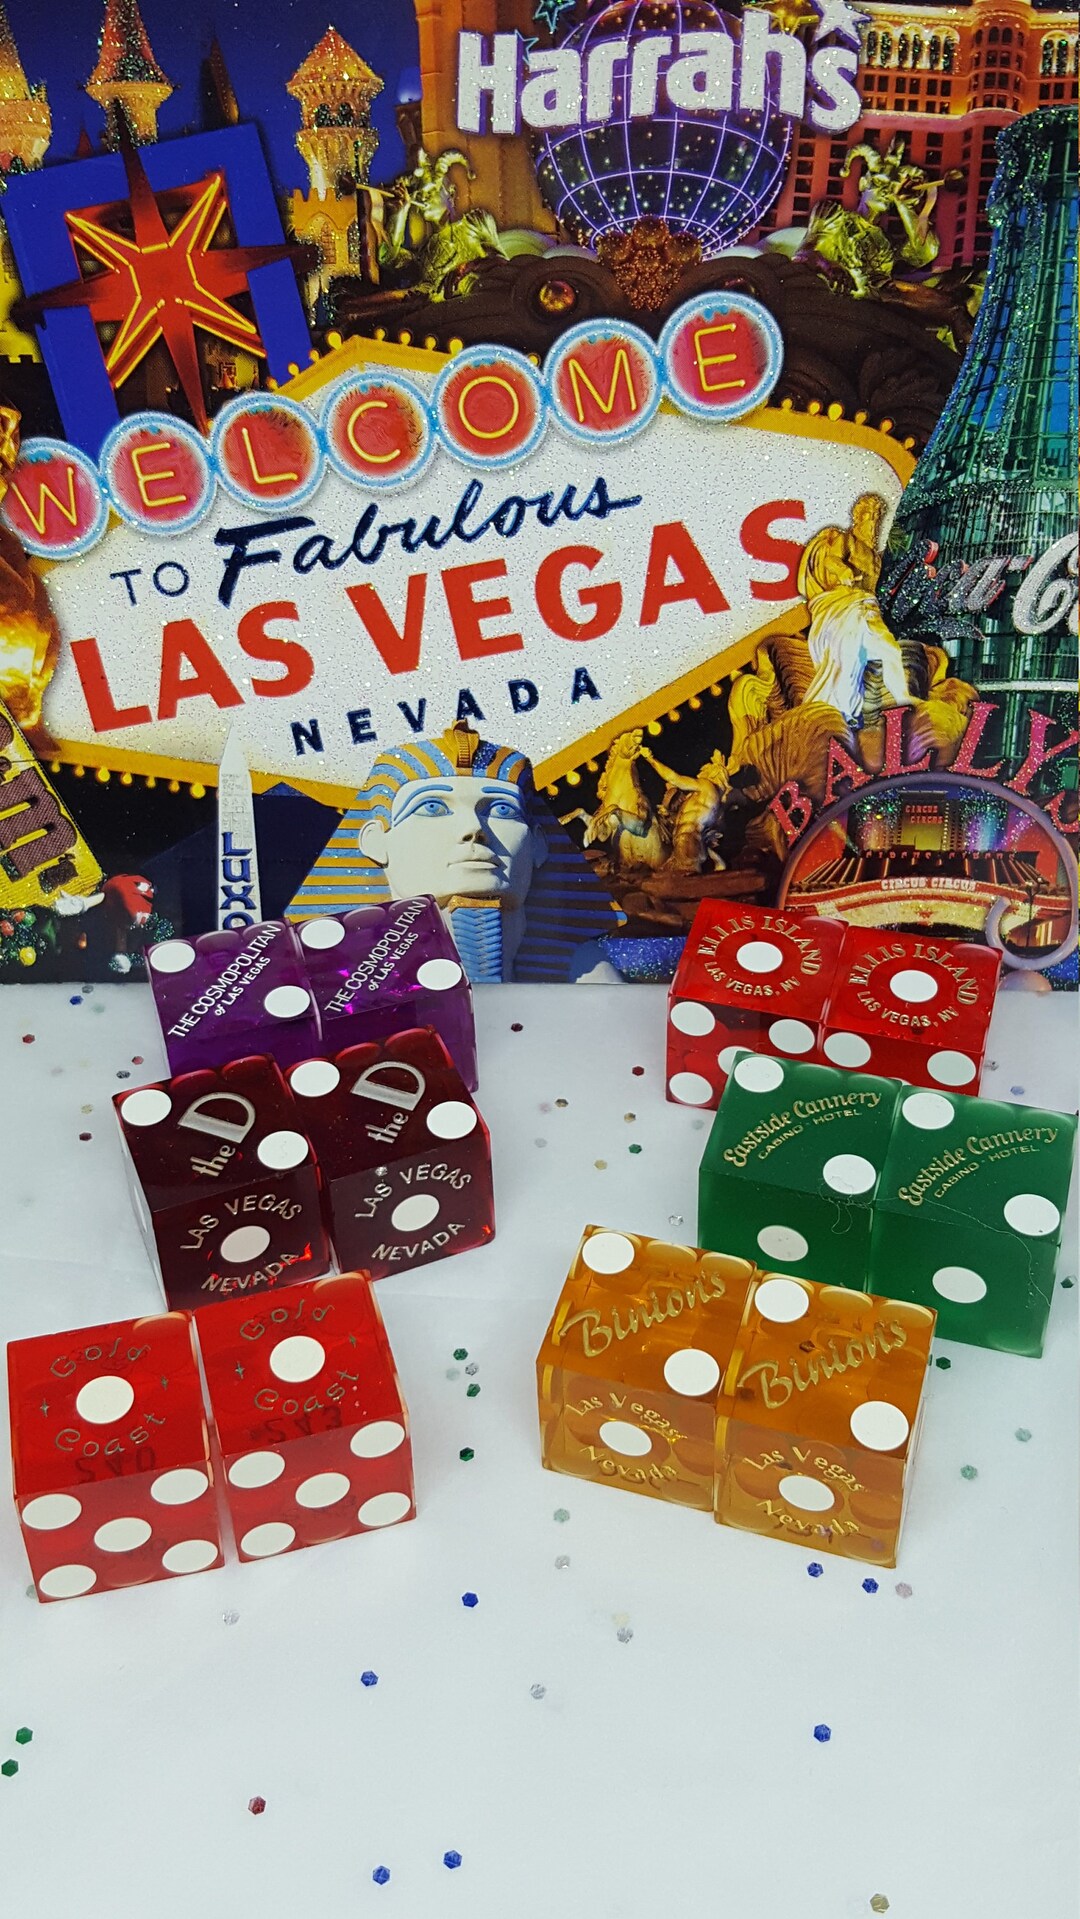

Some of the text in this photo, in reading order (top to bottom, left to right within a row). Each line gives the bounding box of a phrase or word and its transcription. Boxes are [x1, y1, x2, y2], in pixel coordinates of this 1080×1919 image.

[12, 322, 746, 534] WELCOME
[111, 477, 642, 607] TO Fabulous
[70, 500, 807, 733] LAS VEGAS
[291, 667, 602, 755] NEVADA
[881, 876, 977, 892] CIRCUS CIRCUS
[324, 901, 427, 1013] THE COSMOPOLITAN
[368, 932, 419, 991] of LAS VEGAS
[697, 915, 823, 975] ELLIS ISLAND
[168, 924, 282, 1037] THE COSMOPOLITAN
[214, 956, 271, 1016] of LAS VEGAS
[704, 961, 727, 982] LAS
[780, 976, 801, 992] NV
[848, 943, 979, 1005] ELLIS ISLAND
[857, 990, 881, 1012] LAS
[937, 1006, 959, 1022] NV
[350, 1060, 426, 1144] the D
[723, 1092, 882, 1167] Eastside Cannery
[178, 1091, 256, 1177] the D
[757, 1109, 863, 1160] CASINO HOTEL
[354, 1163, 472, 1218] LAS VEGAS
[898, 1127, 1059, 1206] Eastside Cannery
[934, 1145, 1041, 1198] CASINO HOTEL
[180, 1193, 302, 1250] LAS VEGAS
[371, 1220, 466, 1261] NEVADA
[201, 1250, 299, 1292] NEVADA
[240, 1299, 335, 1340] Gold
[50, 1337, 151, 1378] Gold
[254, 1370, 359, 1415] Coast
[566, 1392, 680, 1439] Las Vegas
[55, 1413, 166, 1457] Coast
[579, 1445, 677, 1481] Nevada
[743, 1446, 865, 1492] Las Vegas
[756, 1499, 860, 1535] Nevada
